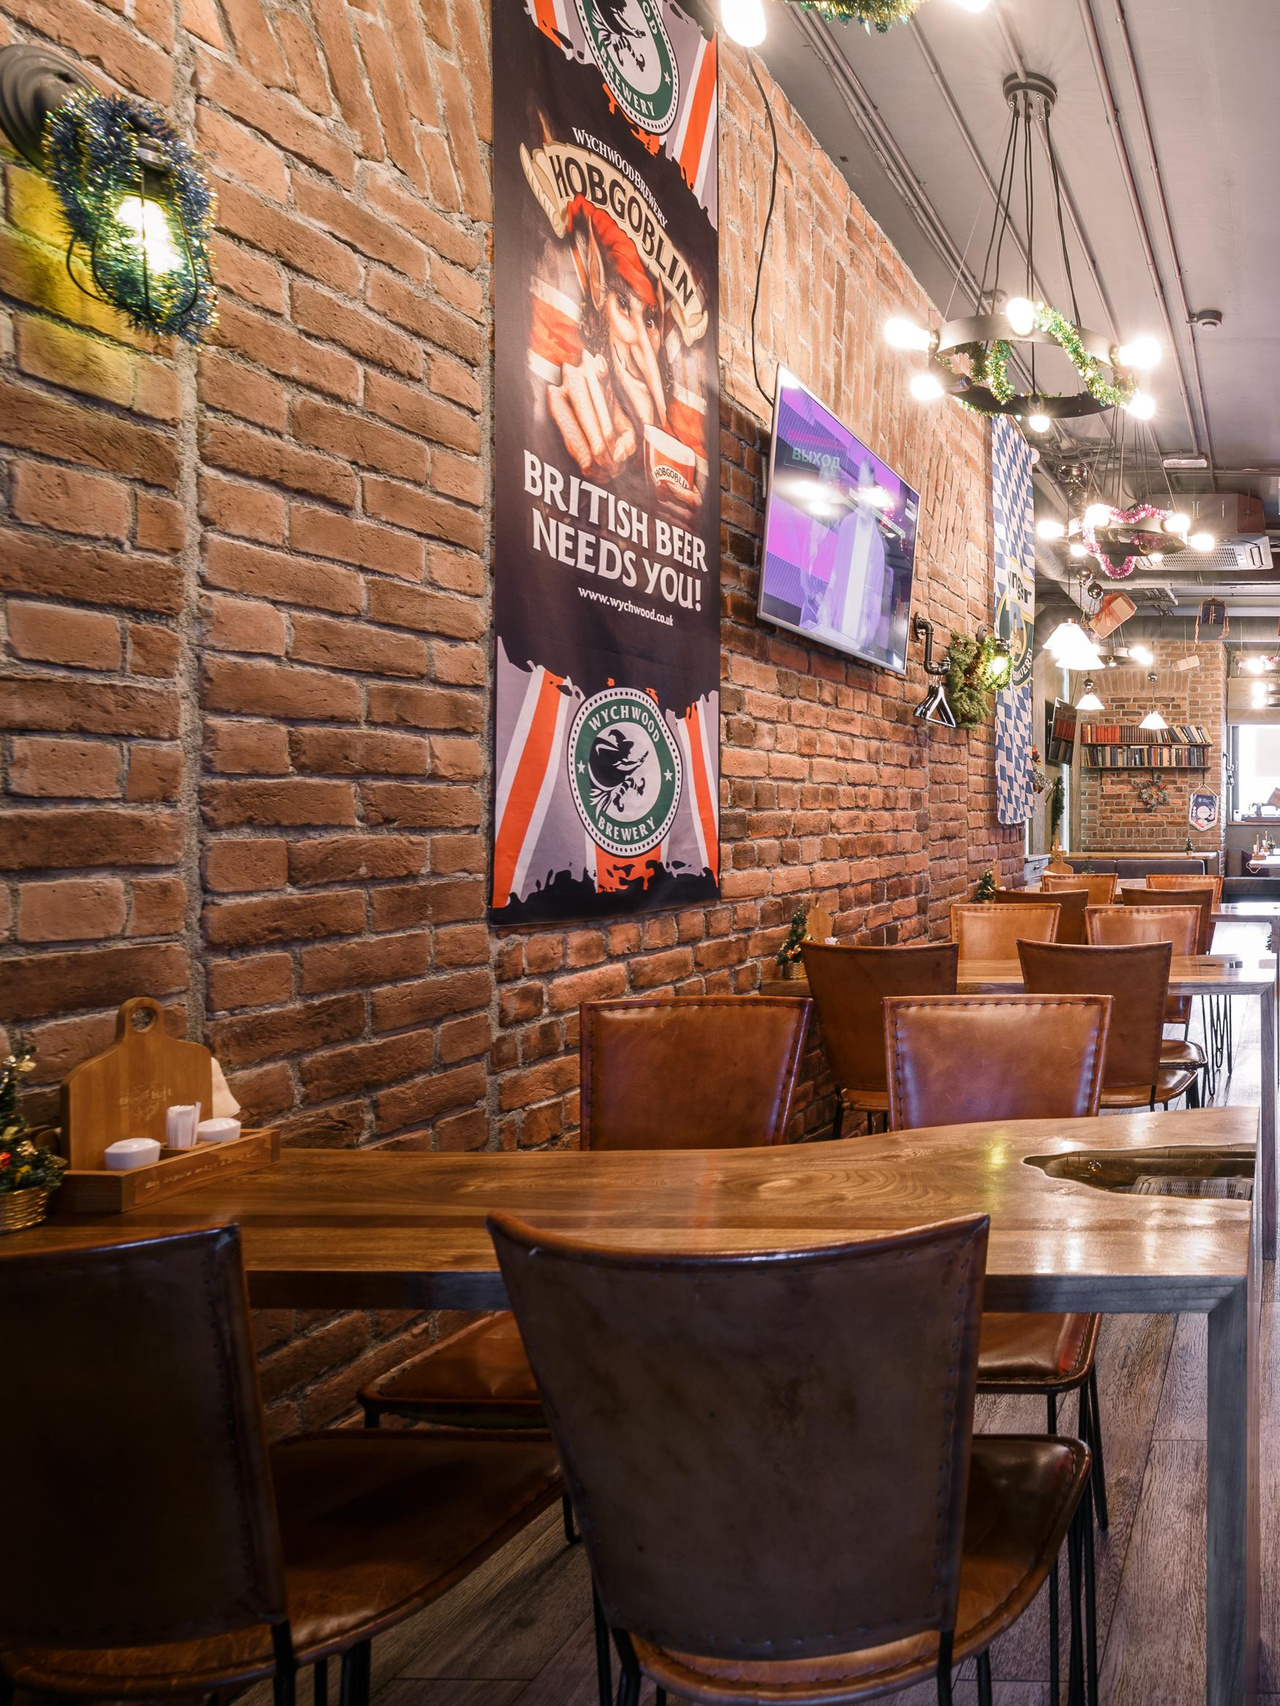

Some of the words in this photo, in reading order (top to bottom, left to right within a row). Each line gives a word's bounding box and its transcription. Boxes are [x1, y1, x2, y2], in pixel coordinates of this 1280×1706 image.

[600, 46, 656, 117] BREWERY
[549, 155, 694, 306] HOBGOBLIN
[791, 446, 841, 471] ВЫХОД
[524, 449, 649, 549] BRITISH
[655, 518, 709, 573] BEER
[532, 507, 638, 588] NEEDS
[641, 557, 702, 612] YOU!
[578, 586, 674, 627] www.wychwood.co.uk
[588, 705, 660, 743] WYCHWOOD
[598, 816, 656, 842] BREWERY
